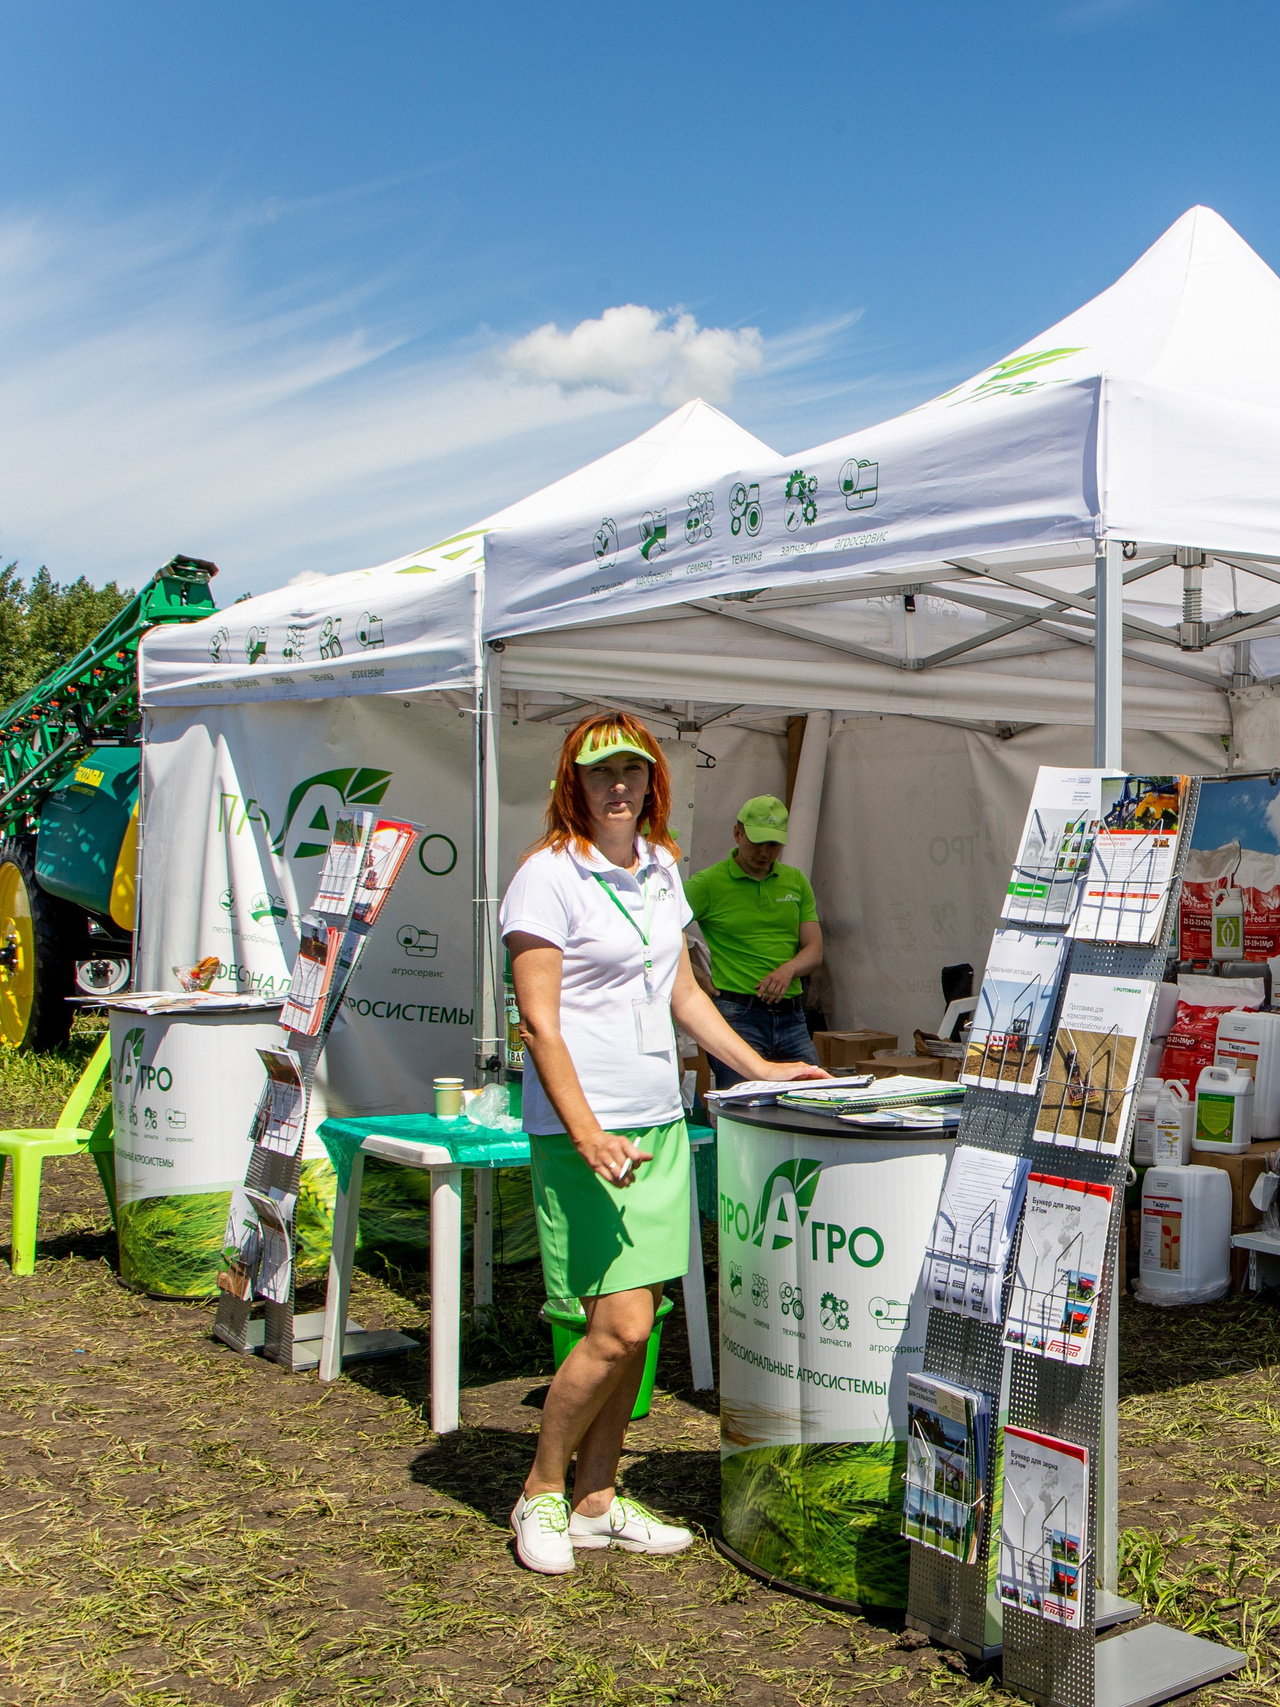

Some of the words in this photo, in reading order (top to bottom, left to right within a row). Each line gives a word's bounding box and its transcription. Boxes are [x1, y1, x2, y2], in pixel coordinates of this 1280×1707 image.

[635, 569, 673, 589] удобрения
[686, 559, 713, 575] семена
[731, 549, 763, 565] техника
[780, 540, 819, 557] запчасти
[834, 530, 889, 550] агросервис
[1244, 914, 1267, 925] y-Feed
[391, 967, 445, 979] агросервис
[1196, 1057, 1206, 1065] 25
[1032, 1196, 1053, 1207] Бункер
[1052, 1201, 1064, 1209] для
[1064, 1203, 1081, 1212] зерна
[753, 1316, 770, 1331] семена
[782, 1327, 806, 1340] техника
[819, 1336, 853, 1349] запчасти
[869, 1342, 925, 1355] агросервис
[796, 1367, 887, 1395] АГРОСИСТЕМЫ
[1010, 1449, 1031, 1463] Бункер
[1030, 1457, 1042, 1465] для
[1042, 1460, 1059, 1471] зерна
